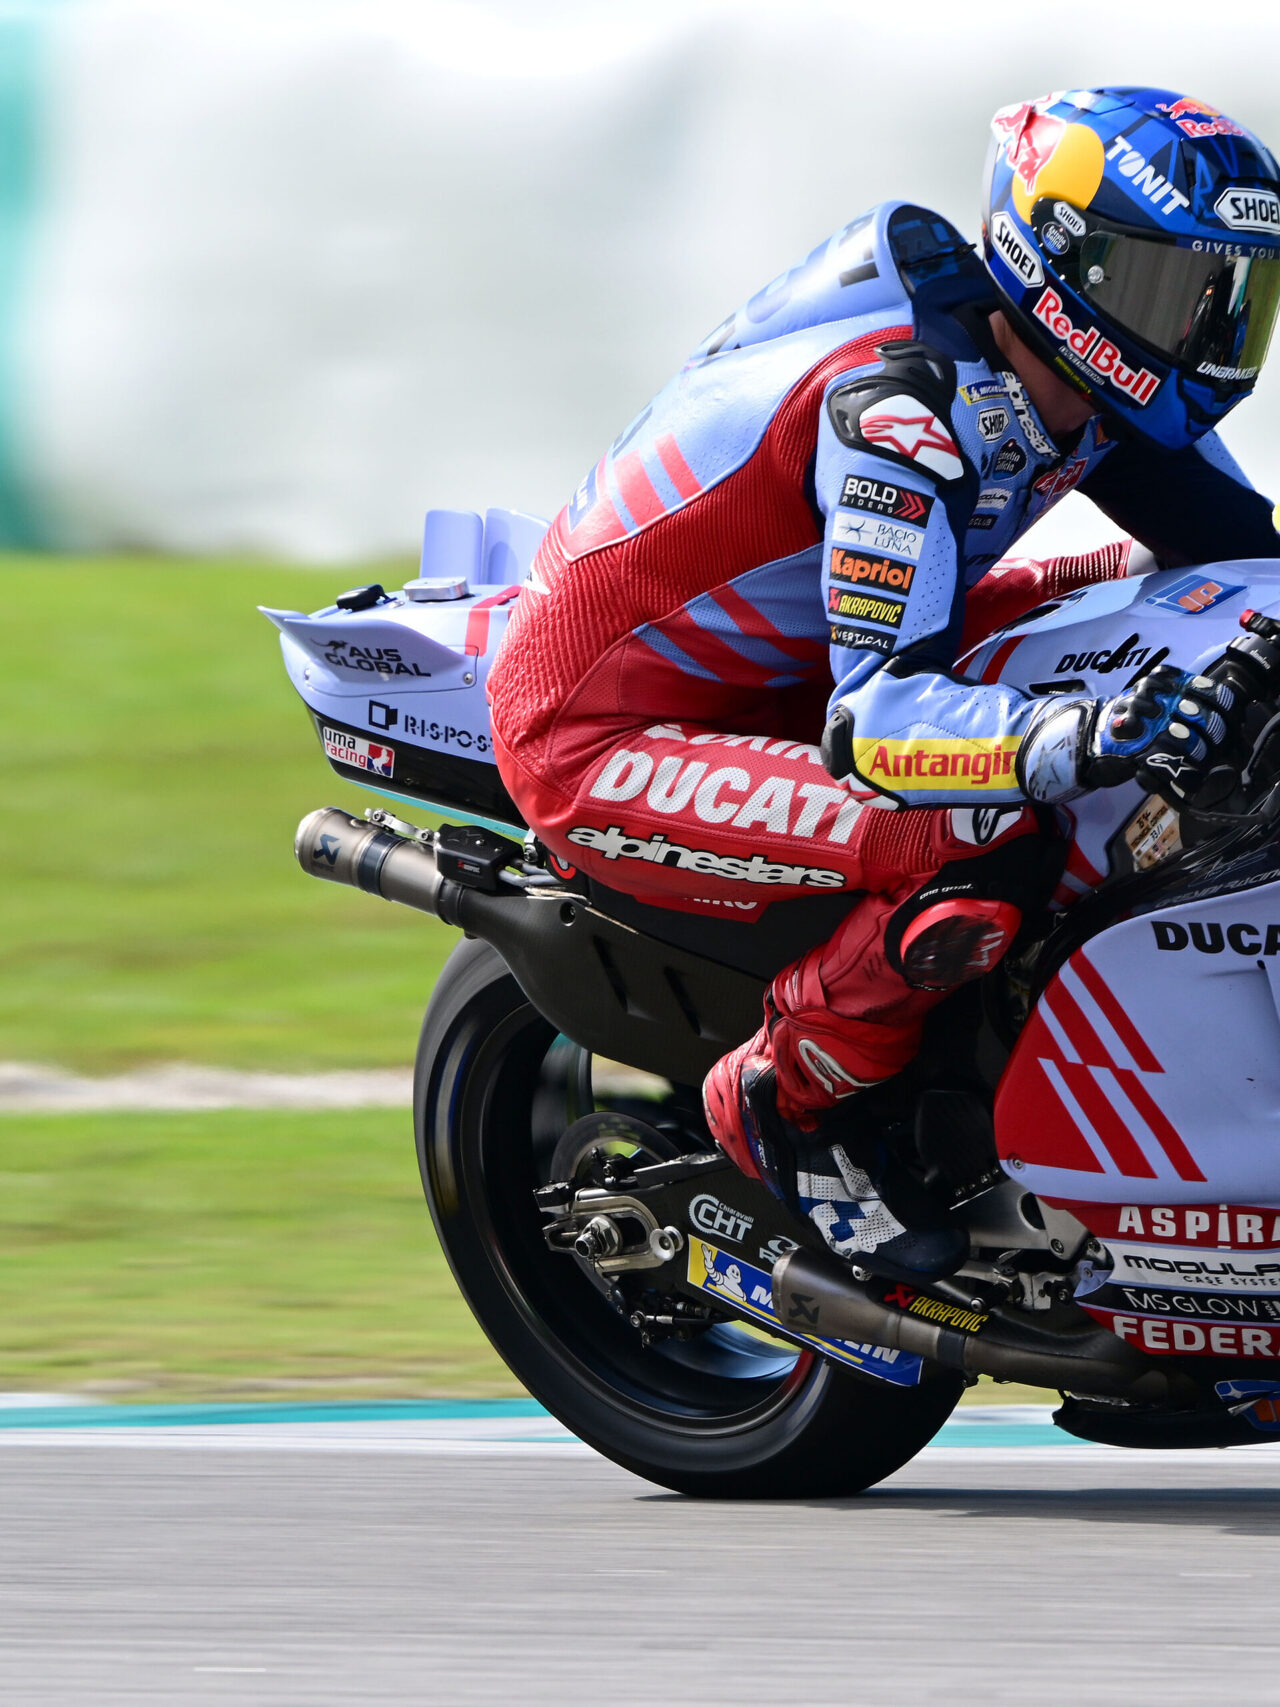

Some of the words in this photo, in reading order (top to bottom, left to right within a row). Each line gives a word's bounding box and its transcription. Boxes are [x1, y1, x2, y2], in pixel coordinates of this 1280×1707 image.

[1104, 135, 1190, 216] TONIT
[1229, 197, 1280, 225] SHOEI
[995, 220, 1036, 281] SHOEI
[1192, 239, 1242, 257] GIVES
[1249, 246, 1276, 260] YOU
[1032, 286, 1101, 360] Red
[1086, 337, 1161, 406] Bull
[1001, 370, 1061, 459] alpinestar
[844, 476, 898, 505] BOLD
[841, 496, 894, 514] RIDERS
[873, 537, 913, 556] LUNA
[829, 548, 914, 590] Kapriol
[324, 652, 432, 678] GLOBAL
[349, 646, 402, 661] AUS
[324, 728, 356, 750] uma
[326, 741, 367, 768] racing
[590, 748, 865, 845] DUCATI
[566, 826, 846, 888] alpinestars
[698, 1202, 753, 1241] CHT
[1183, 1274, 1223, 1286] CASE
